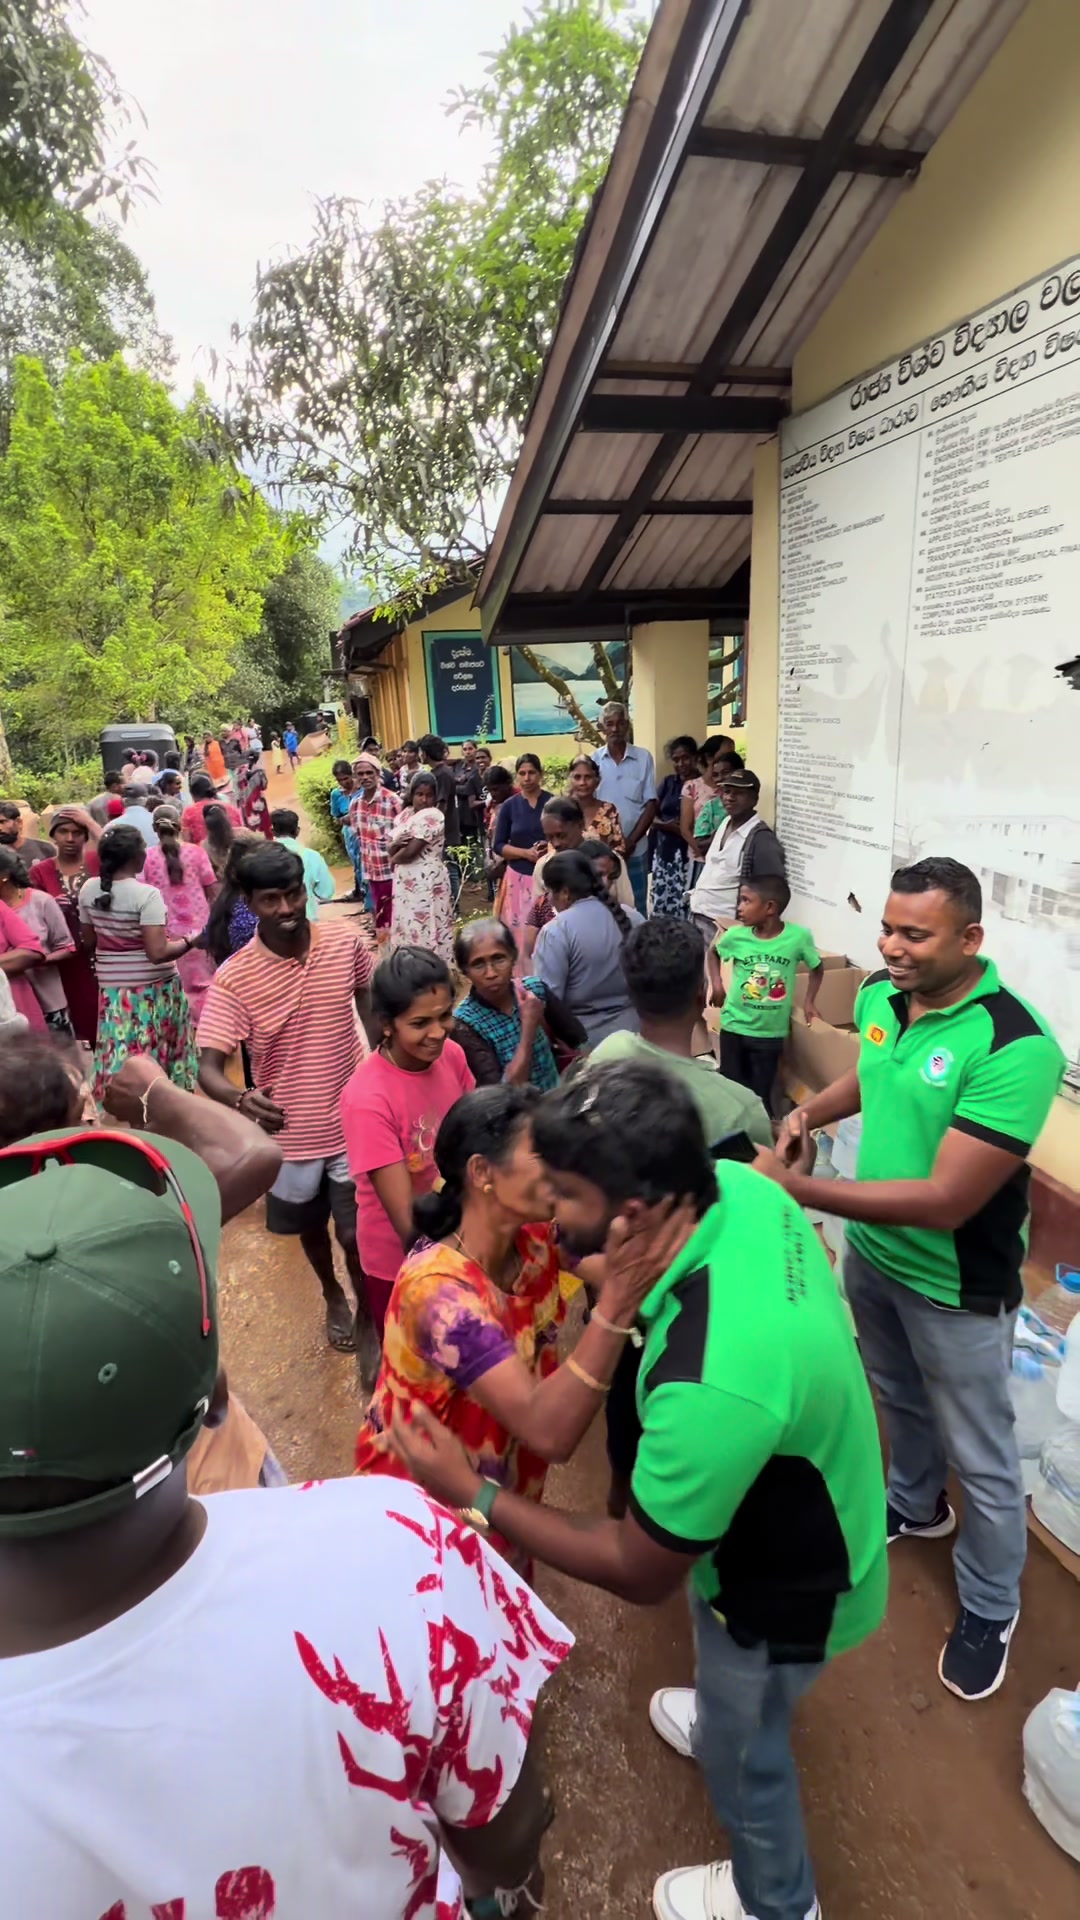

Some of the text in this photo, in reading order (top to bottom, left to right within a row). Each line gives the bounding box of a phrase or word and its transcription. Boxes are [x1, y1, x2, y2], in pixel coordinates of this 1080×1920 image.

[963, 480, 990, 496] SCIENCE
[963, 501, 990, 515] SCIENCE
[953, 524, 979, 538] SCIENCE
[928, 549, 961, 562] TRANSPORT
[962, 545, 975, 554] AND
[977, 537, 1010, 552] LOGISTICS
[959, 562, 994, 575] STATISTICS
[963, 580, 1003, 594] OPERATIONS
[1005, 573, 1043, 587] RESEARCH
[956, 606, 968, 614] AND
[970, 600, 1013, 612] INFORMATION
[1015, 594, 1049, 606] SYSTEMS
[948, 624, 973, 635] SCIENCE
